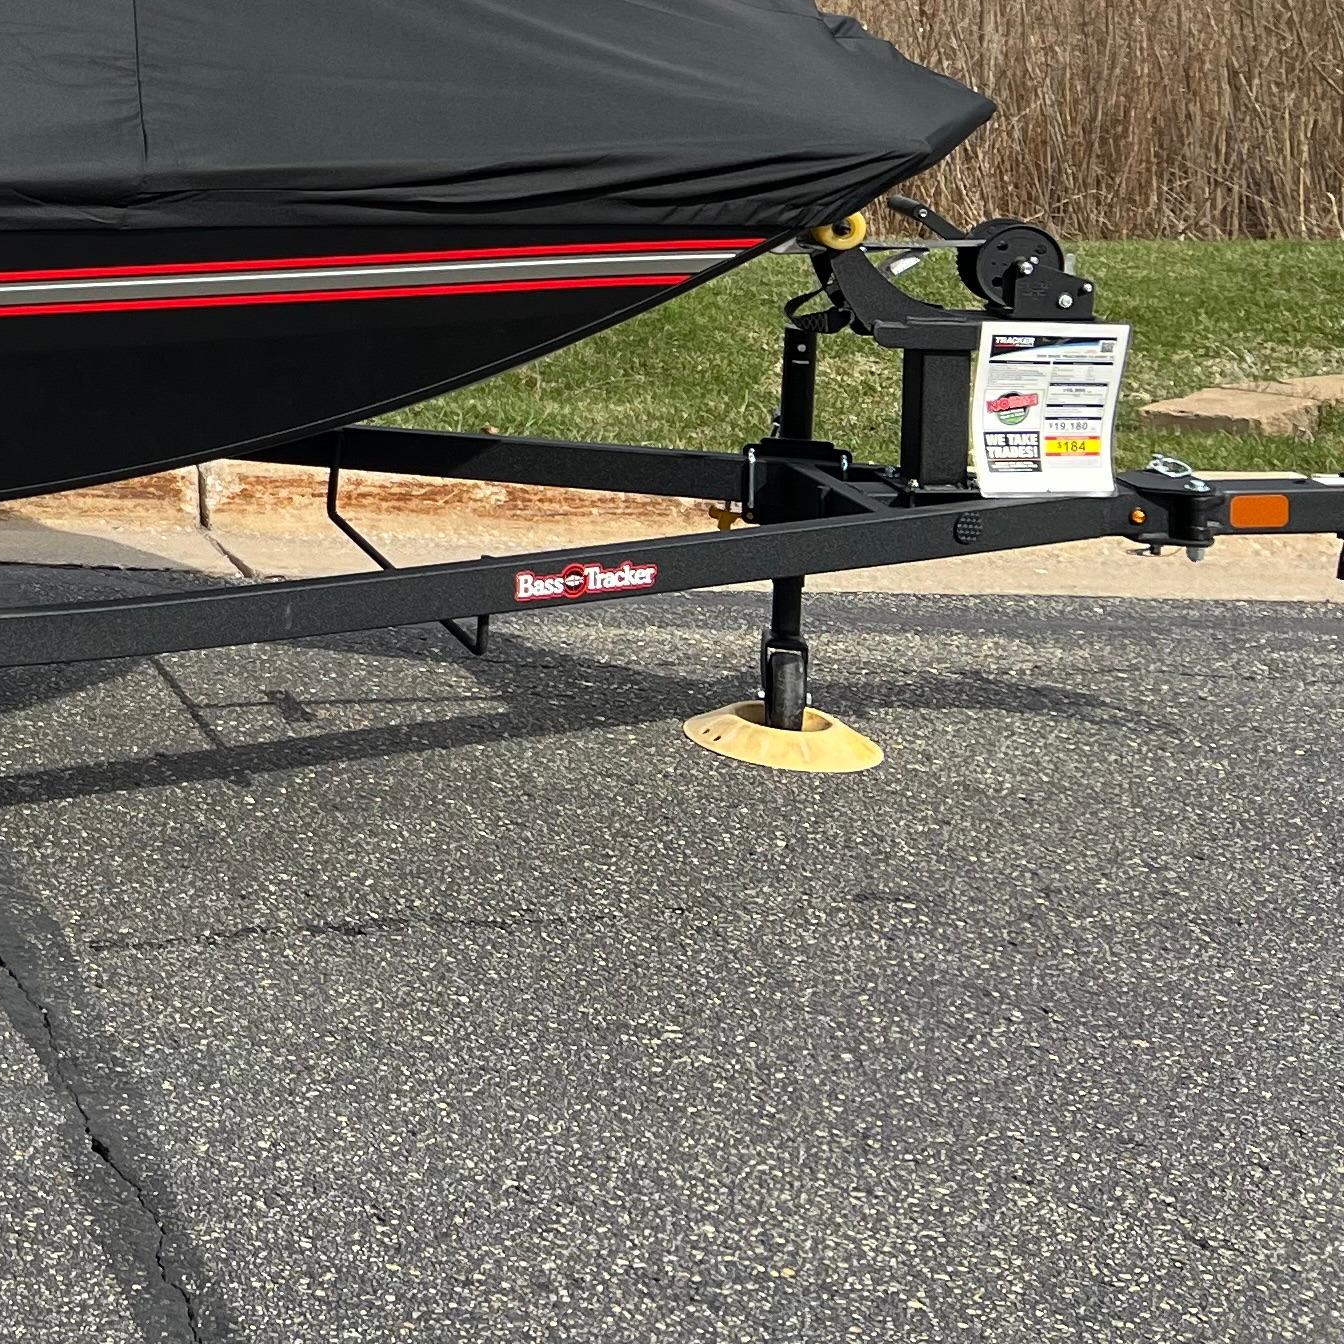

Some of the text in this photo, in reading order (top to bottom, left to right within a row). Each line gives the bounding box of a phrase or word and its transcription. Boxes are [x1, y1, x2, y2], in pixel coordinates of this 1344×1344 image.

[994, 337, 1035, 345] TRACKER
[986, 434, 1038, 445] WE TAKE
[986, 446, 1038, 458] TRADES!
[518, 565, 655, 598] Bass Tracker
